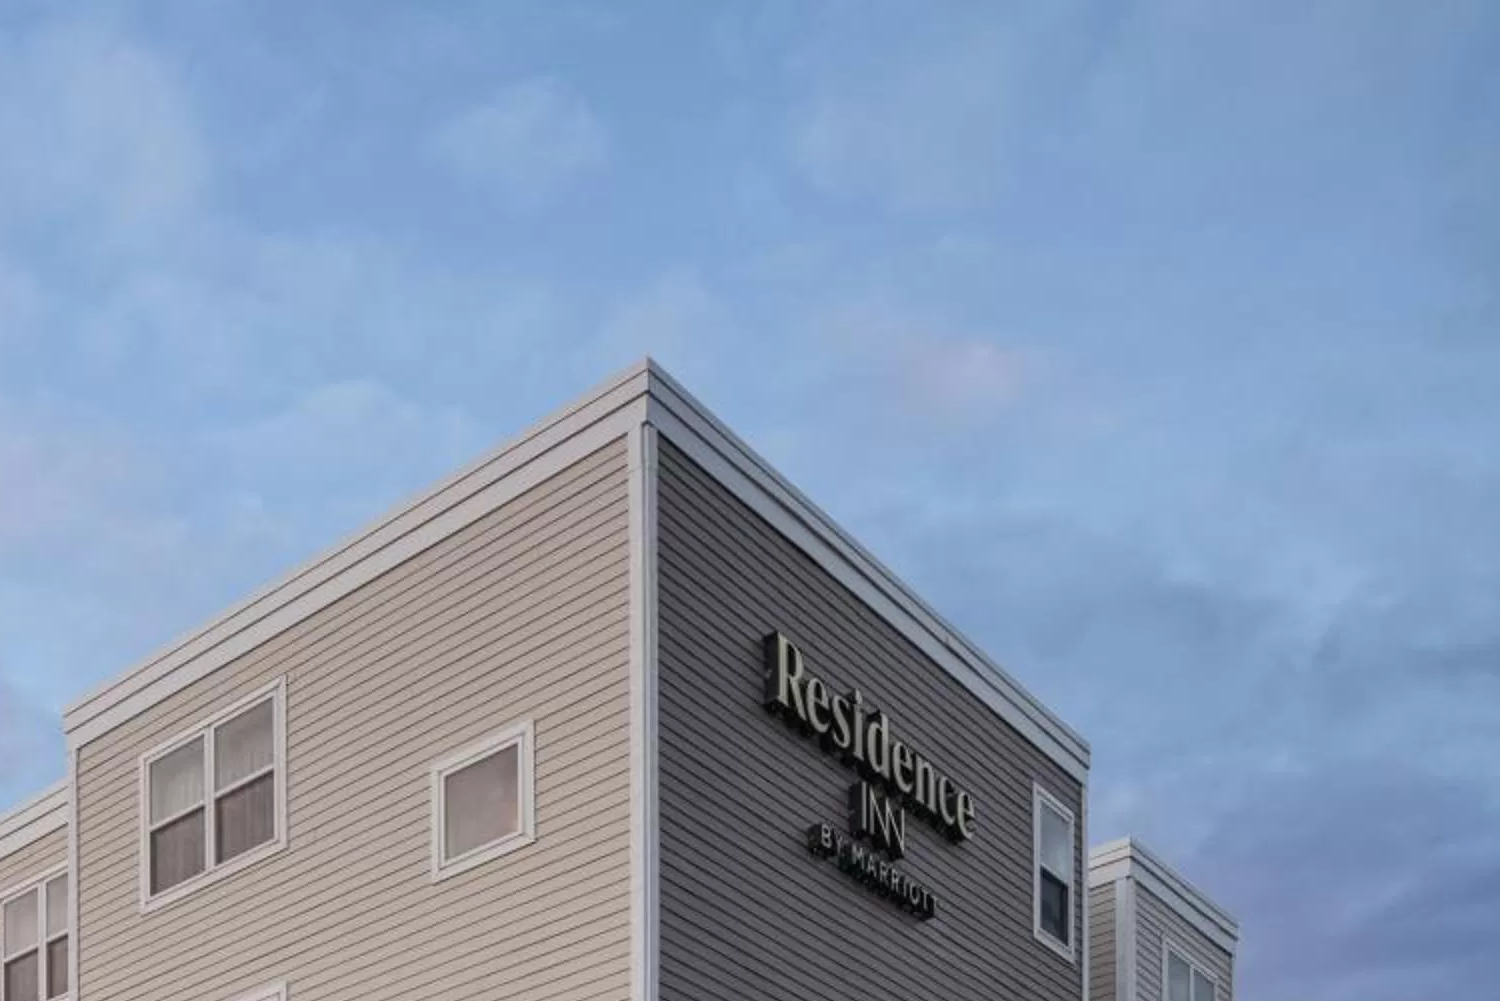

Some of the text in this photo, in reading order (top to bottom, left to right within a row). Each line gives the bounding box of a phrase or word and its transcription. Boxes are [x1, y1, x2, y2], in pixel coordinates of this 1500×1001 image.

[776, 631, 976, 841] Residence
[861, 780, 905, 855] INN
[820, 822, 938, 913] BY MARRIOTT
